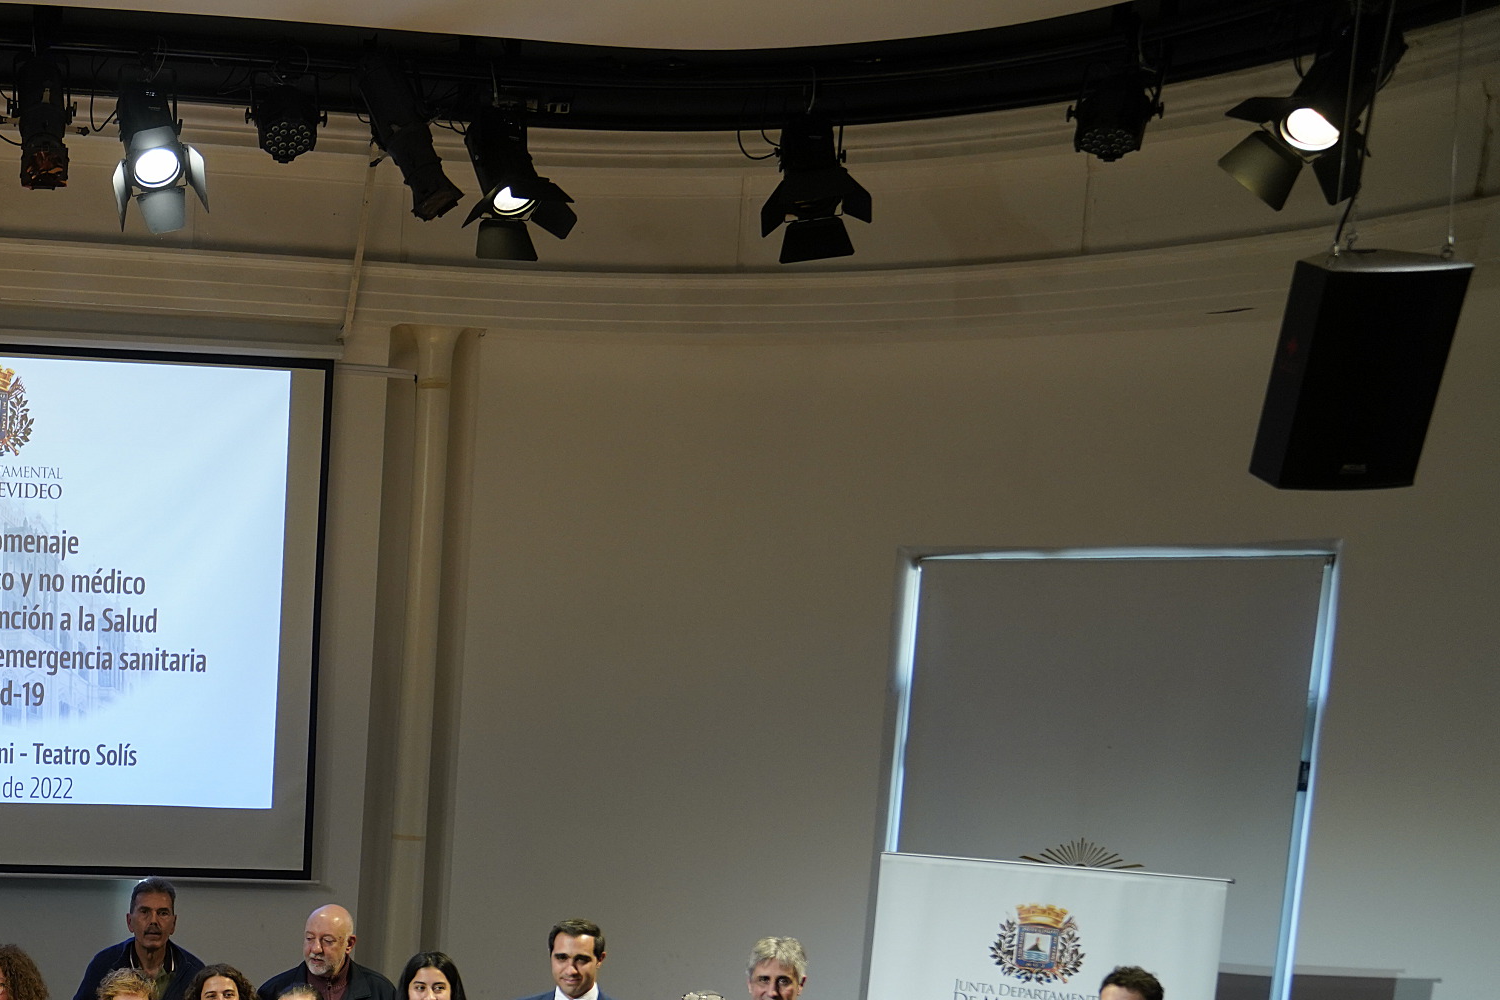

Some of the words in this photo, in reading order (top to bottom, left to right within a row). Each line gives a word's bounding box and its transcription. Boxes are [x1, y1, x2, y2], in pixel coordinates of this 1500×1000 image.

[20, 572, 33, 598] y
[39, 573, 64, 592] no
[71, 567, 146, 595] médico
[59, 612, 71, 631] a
[78, 605, 95, 632] la
[101, 607, 158, 633] Salud
[119, 647, 207, 672] sanitaria
[33, 743, 90, 766] Teatro
[95, 743, 137, 766] Solís
[2, 775, 24, 798] de
[29, 776, 73, 799] 2022
[954, 978, 995, 995] JUNTA
